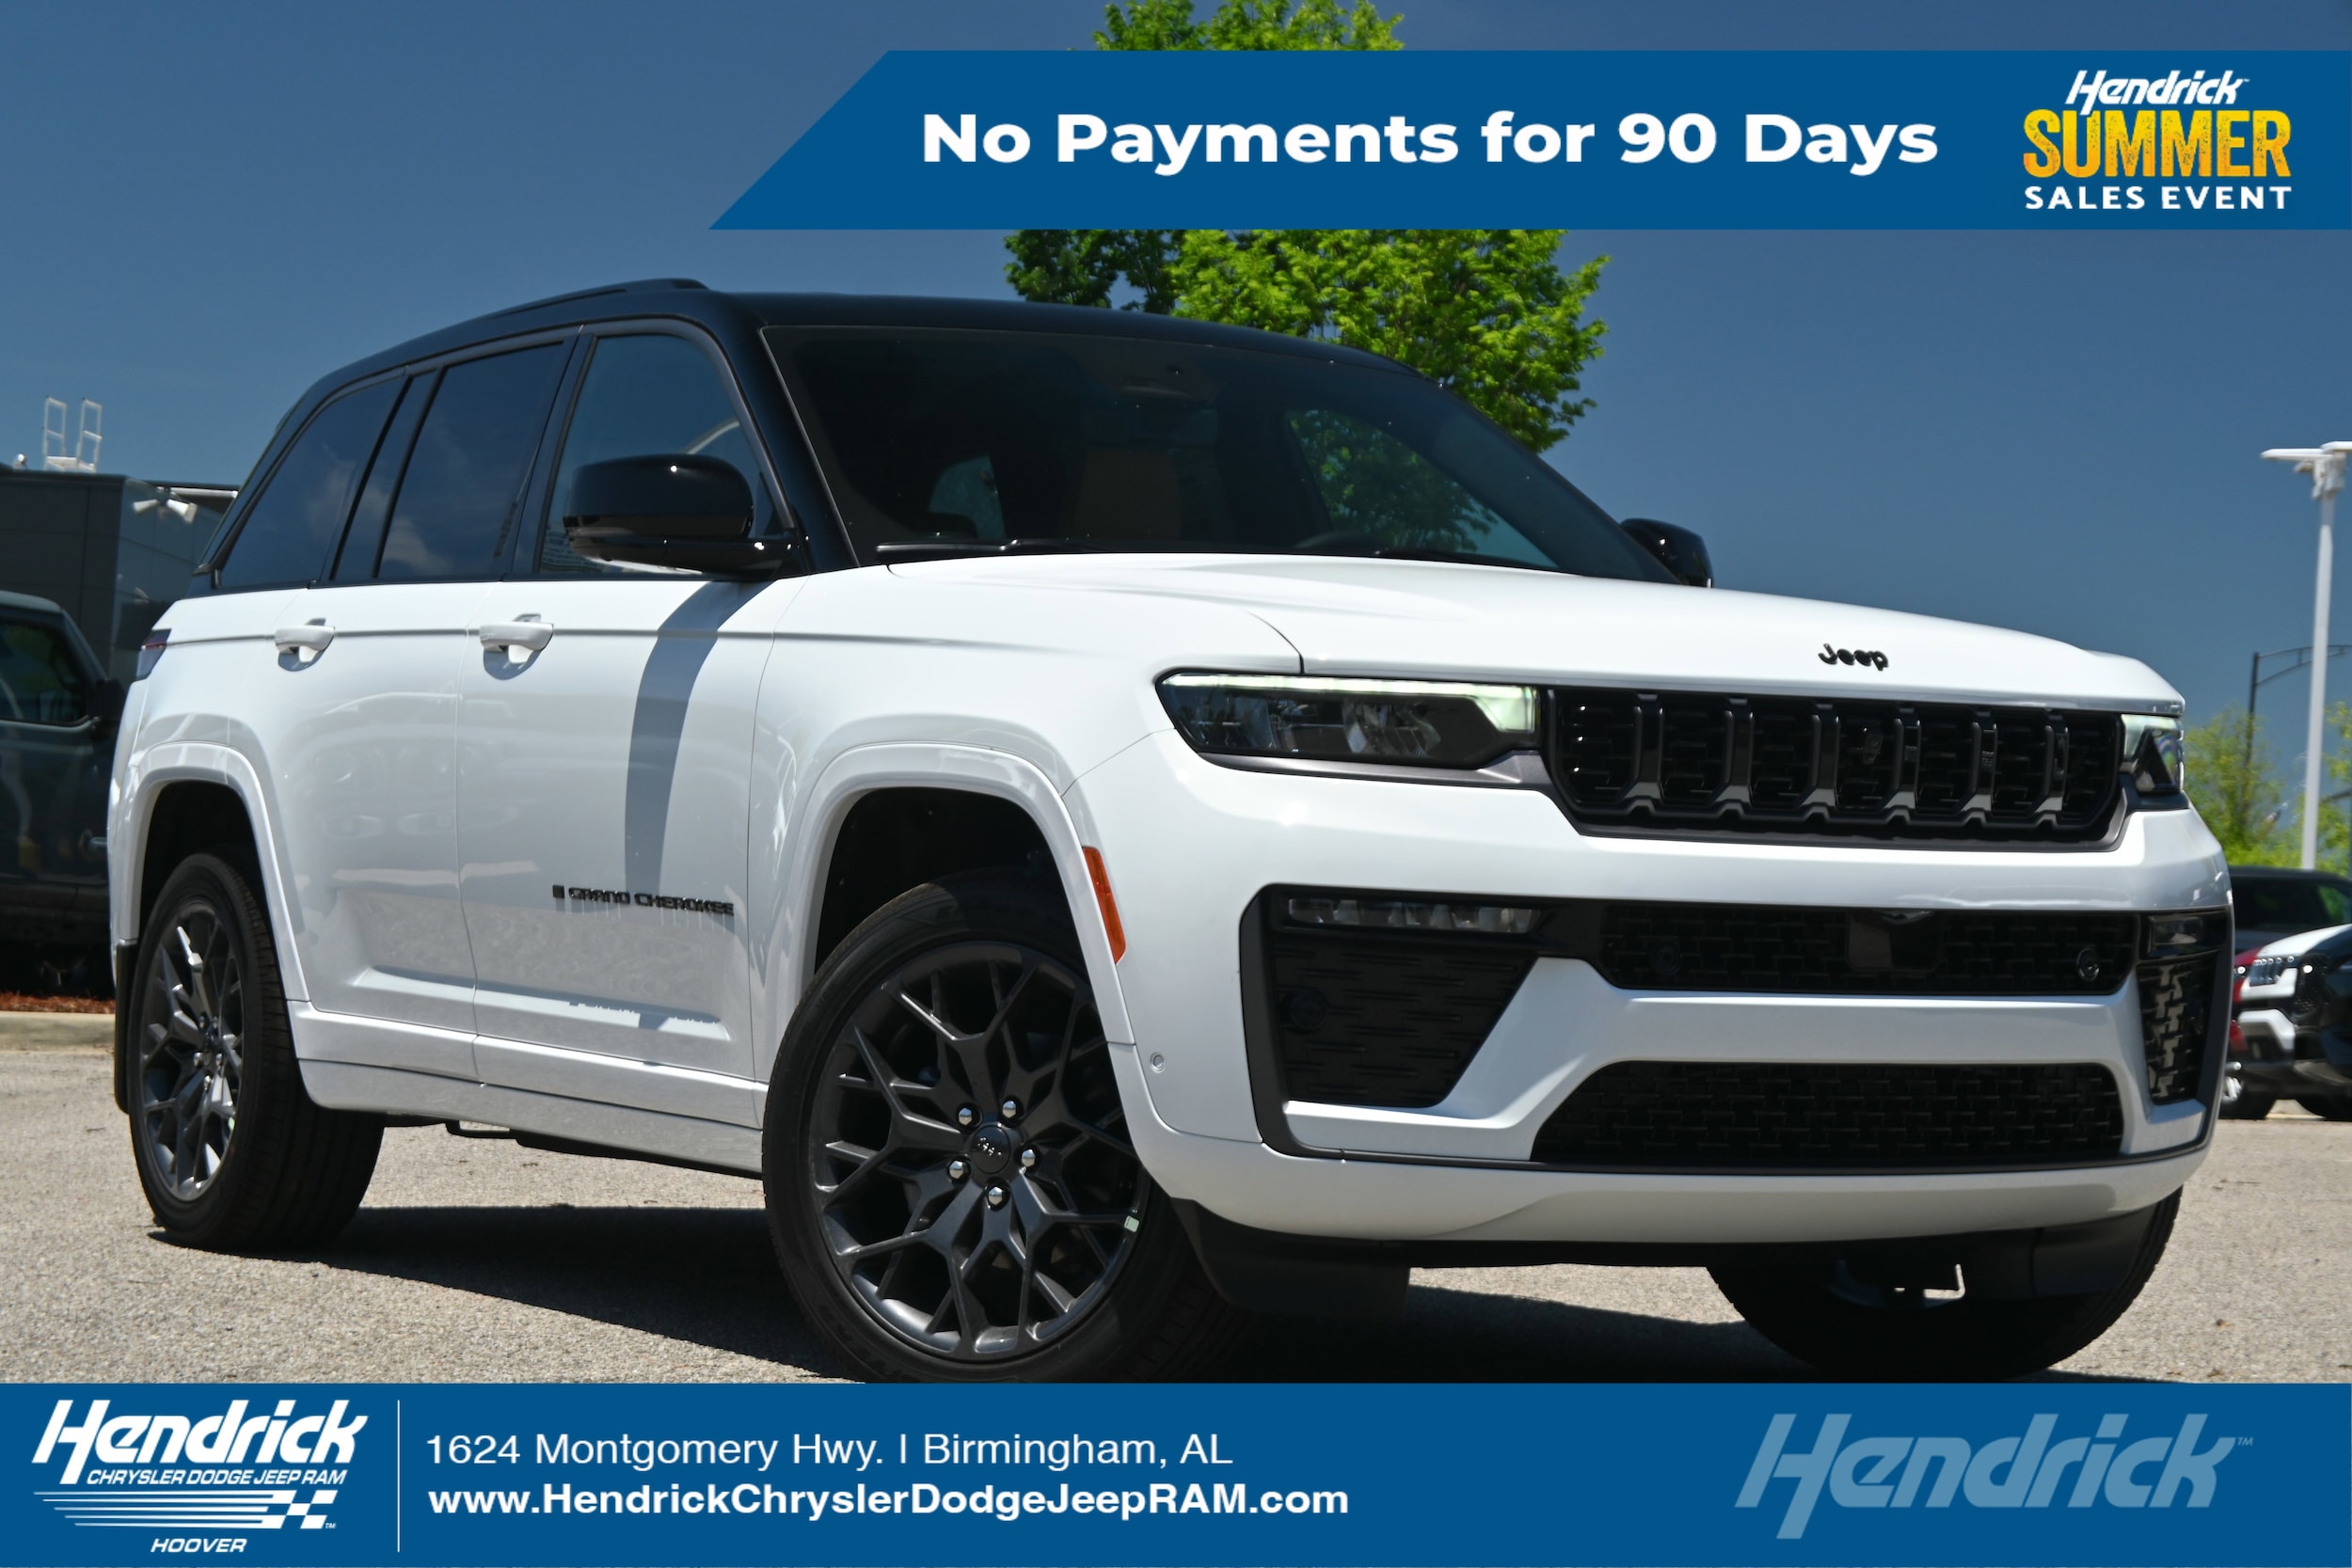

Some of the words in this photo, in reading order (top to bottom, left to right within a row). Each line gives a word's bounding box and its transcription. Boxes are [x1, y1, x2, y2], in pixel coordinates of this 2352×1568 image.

[1818, 642, 1889, 672] Jeep
[568, 887, 630, 904] GRAND
[634, 893, 735, 916] CHEROKEE
